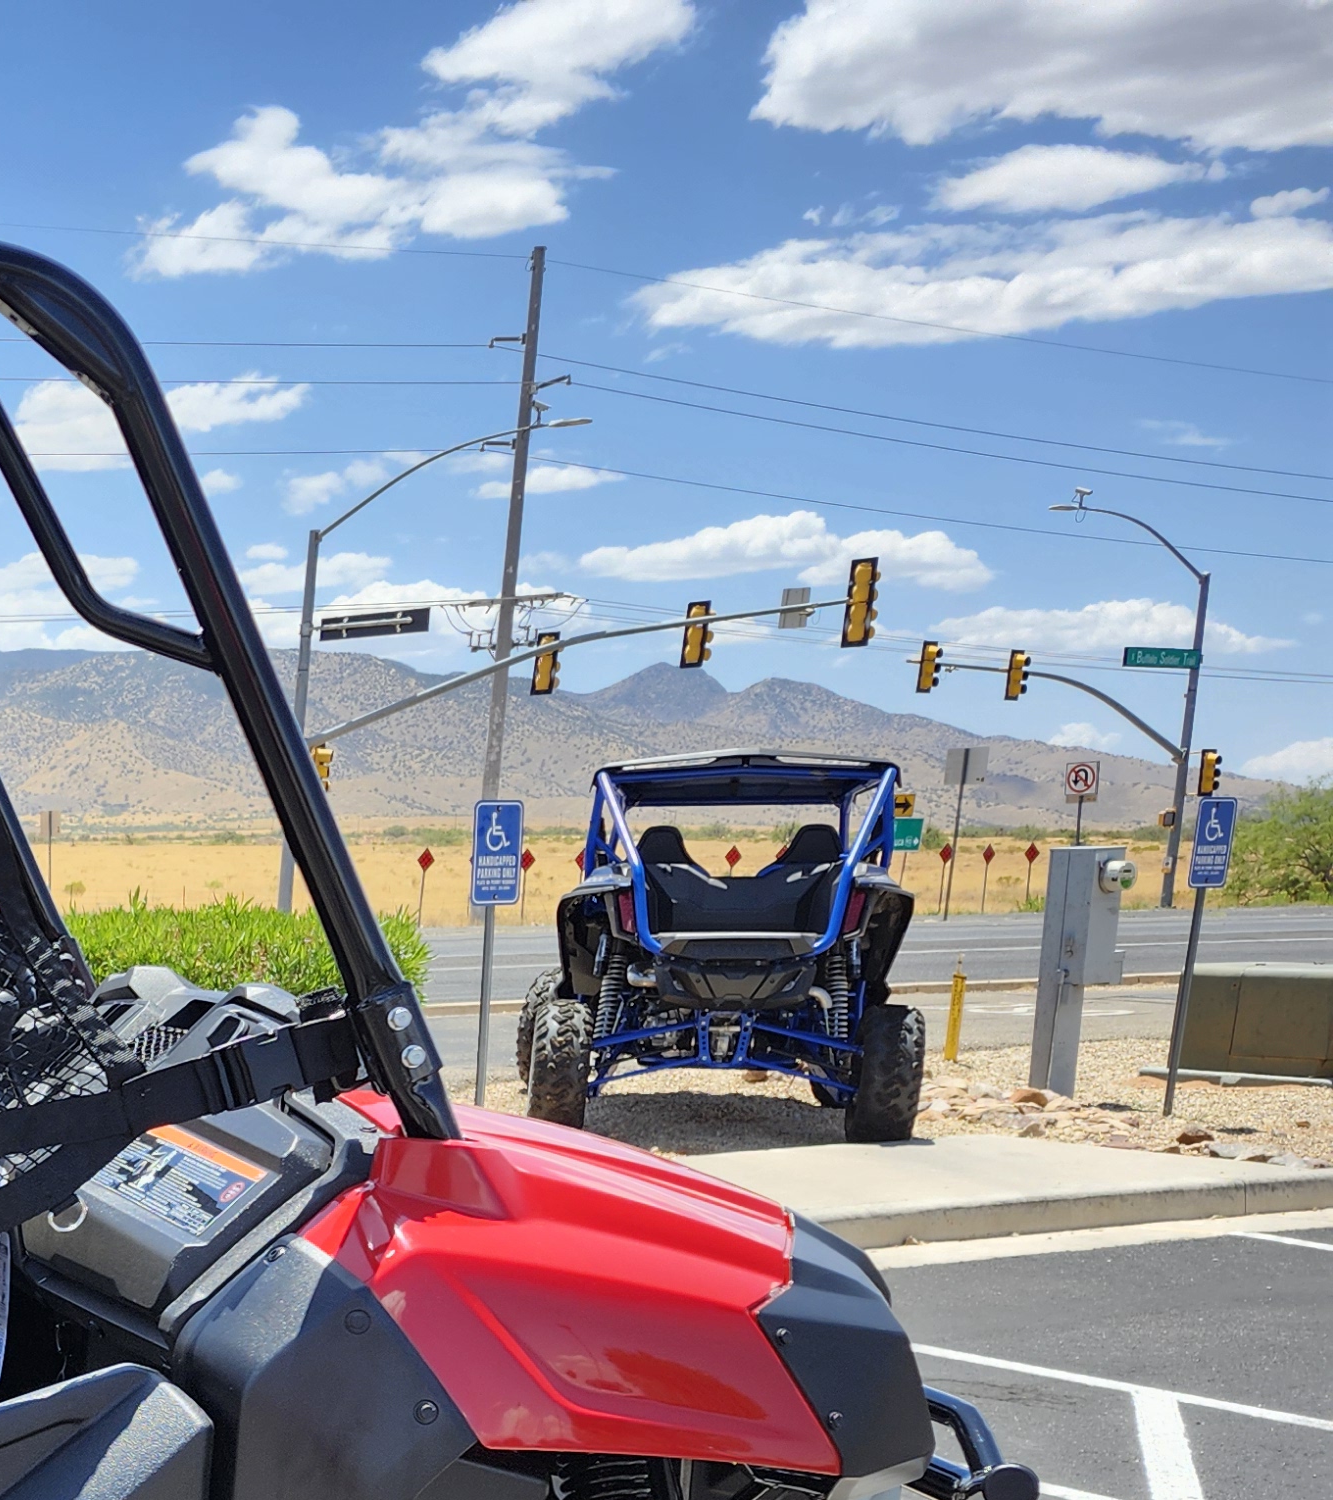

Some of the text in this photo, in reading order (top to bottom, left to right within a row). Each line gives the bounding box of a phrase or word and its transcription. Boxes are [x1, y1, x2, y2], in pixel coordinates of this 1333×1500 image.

[478, 855, 516, 866] HANDICAPPED
[477, 867, 516, 879] PARKING ONLY
